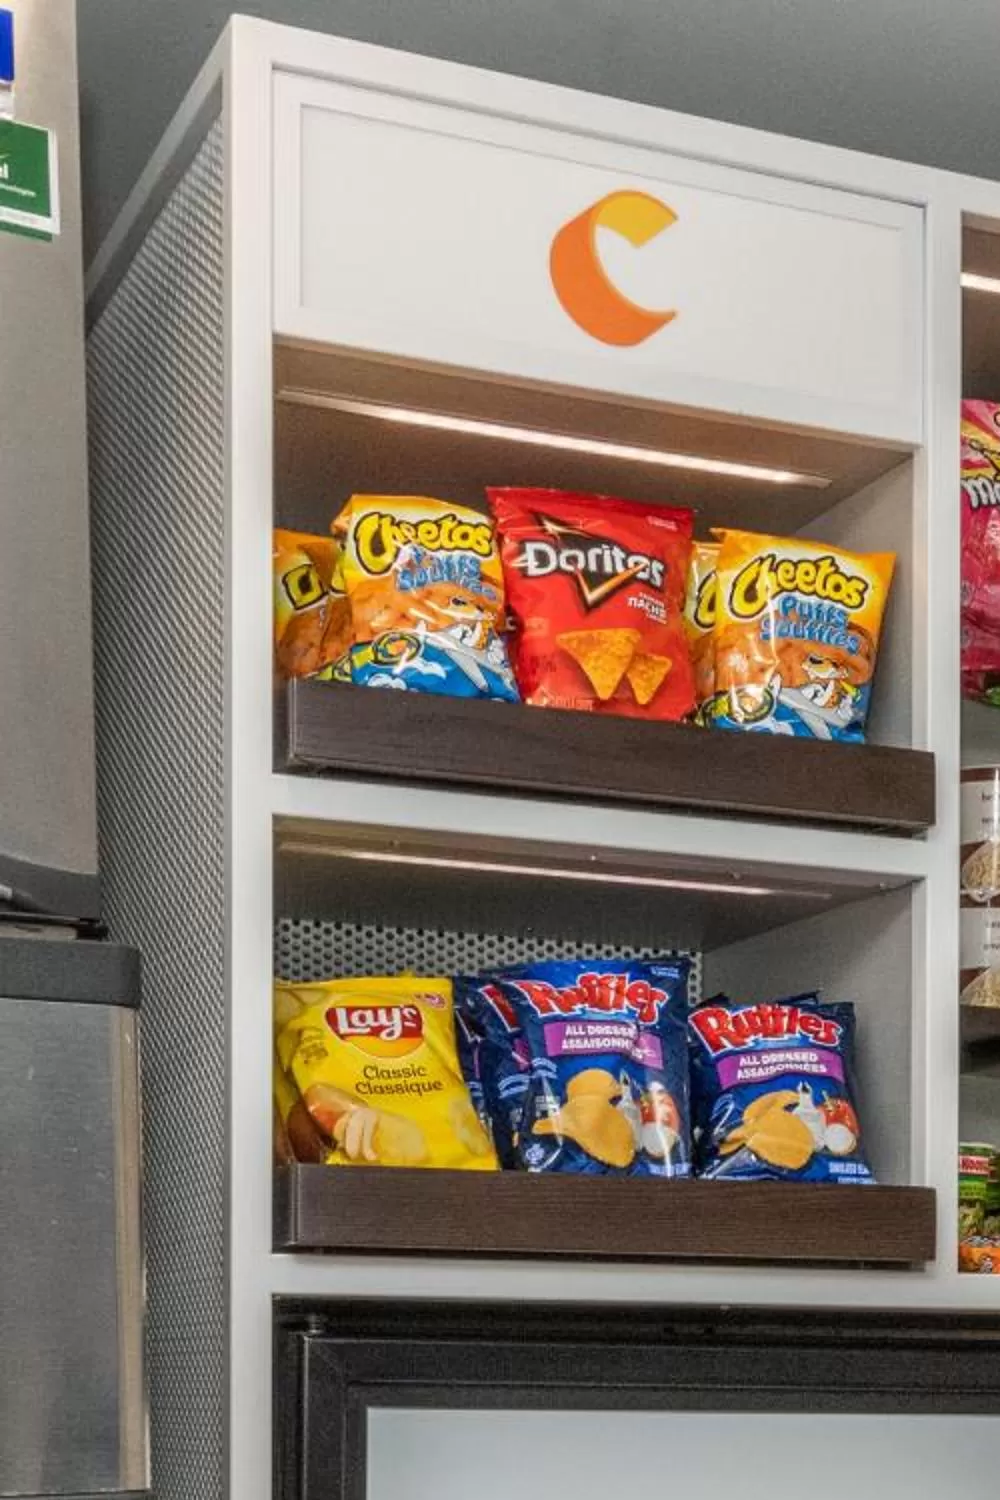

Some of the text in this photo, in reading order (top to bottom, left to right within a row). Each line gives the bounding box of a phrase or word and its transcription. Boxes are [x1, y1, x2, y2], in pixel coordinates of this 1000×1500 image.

[354, 512, 493, 576] Cheetos
[525, 541, 665, 588] Doritos
[730, 553, 869, 619] Cheetos
[335, 1005, 419, 1040] Lay's
[688, 1003, 843, 1058] Ruffles
[362, 1064, 428, 1081] Classic
[740, 1053, 760, 1067] ALL
[355, 1080, 444, 1097] Classique
